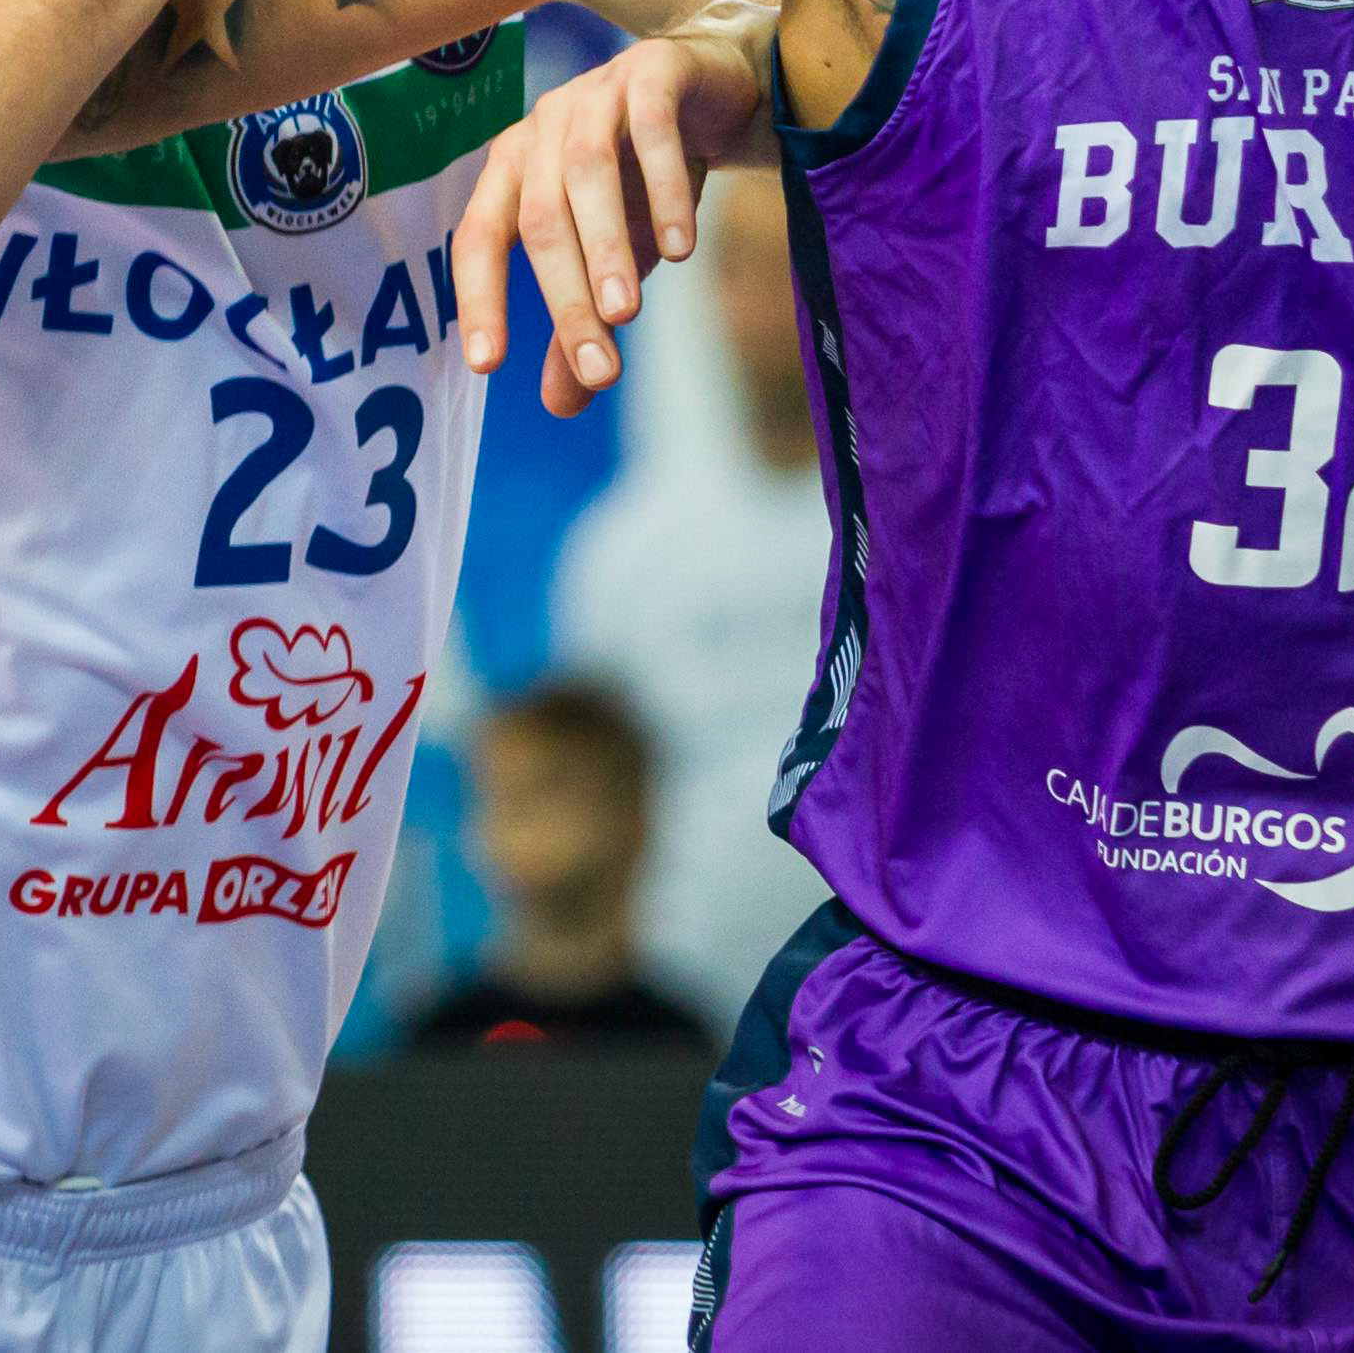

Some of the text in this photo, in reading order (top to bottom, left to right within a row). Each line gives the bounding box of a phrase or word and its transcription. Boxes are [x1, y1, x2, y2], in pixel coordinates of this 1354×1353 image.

[194, 376, 424, 588] 23
[29, 653, 426, 839] Anwil
[9, 862, 345, 919] GRUPA ORLEN
